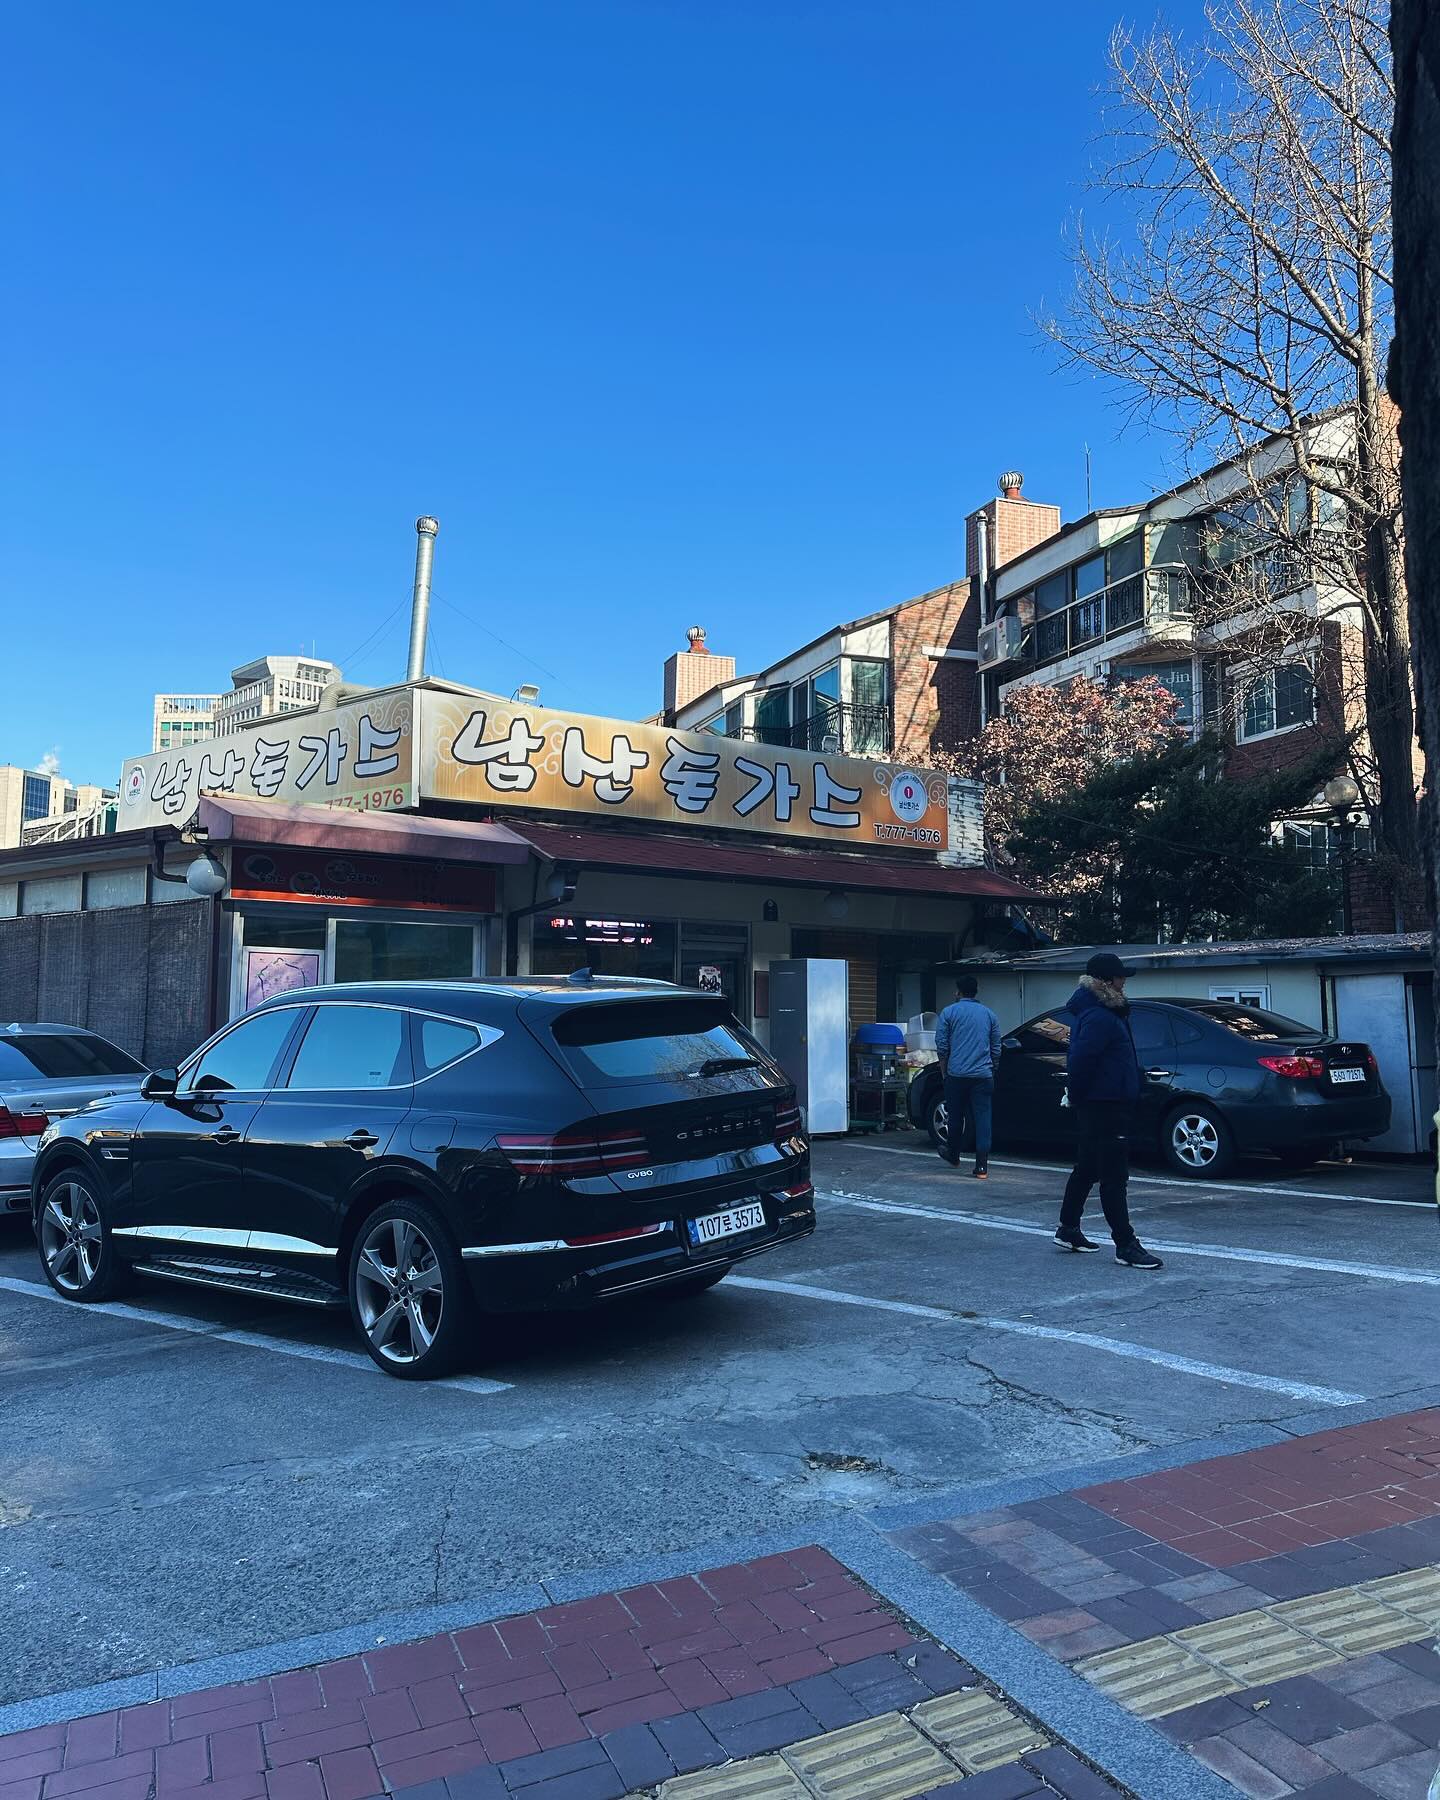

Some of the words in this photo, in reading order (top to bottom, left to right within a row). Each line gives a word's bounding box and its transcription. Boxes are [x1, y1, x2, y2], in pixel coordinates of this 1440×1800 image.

[1166, 671, 1191, 684] Jin
[452, 711, 862, 828] 남산돈가스
[873, 823, 941, 843] T.777-1976
[627, 1170, 653, 1179] GV80
[698, 1215, 732, 1239] 107로
[733, 1206, 762, 1229] 3573
